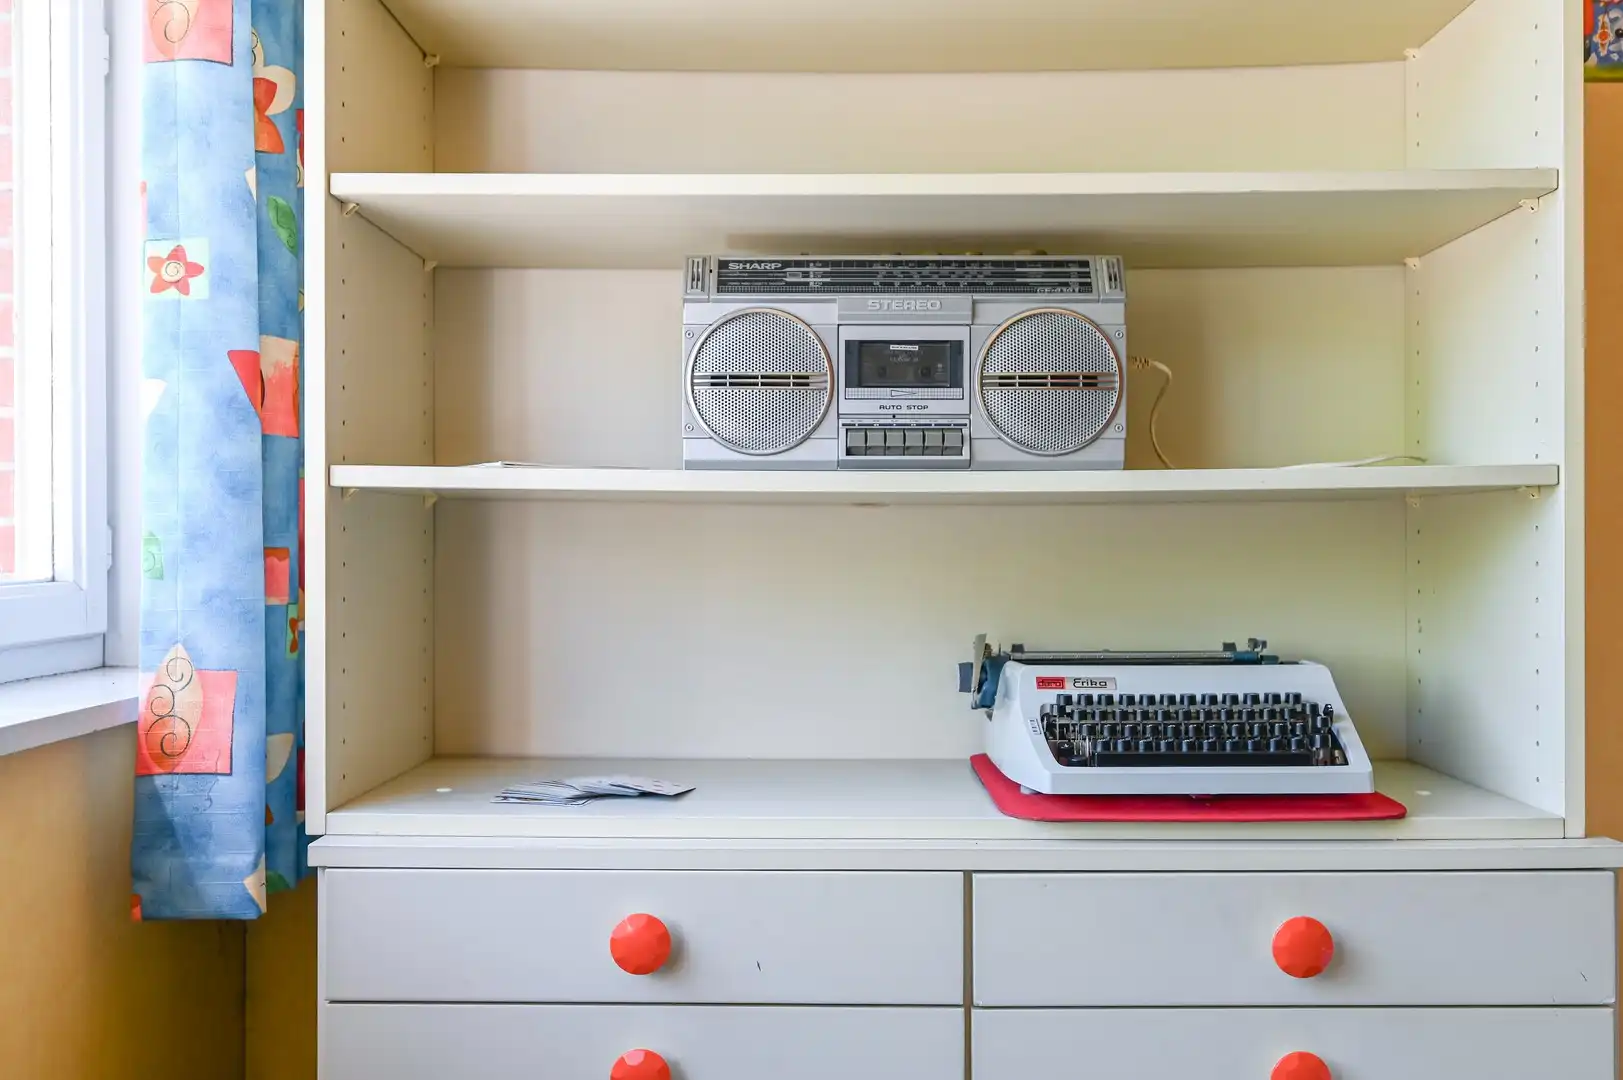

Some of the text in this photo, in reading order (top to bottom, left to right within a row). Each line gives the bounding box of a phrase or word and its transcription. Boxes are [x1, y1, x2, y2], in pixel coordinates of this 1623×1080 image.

[728, 262, 782, 270] SHARP
[867, 299, 942, 311] STEREO
[1073, 677, 1108, 689] Erika
